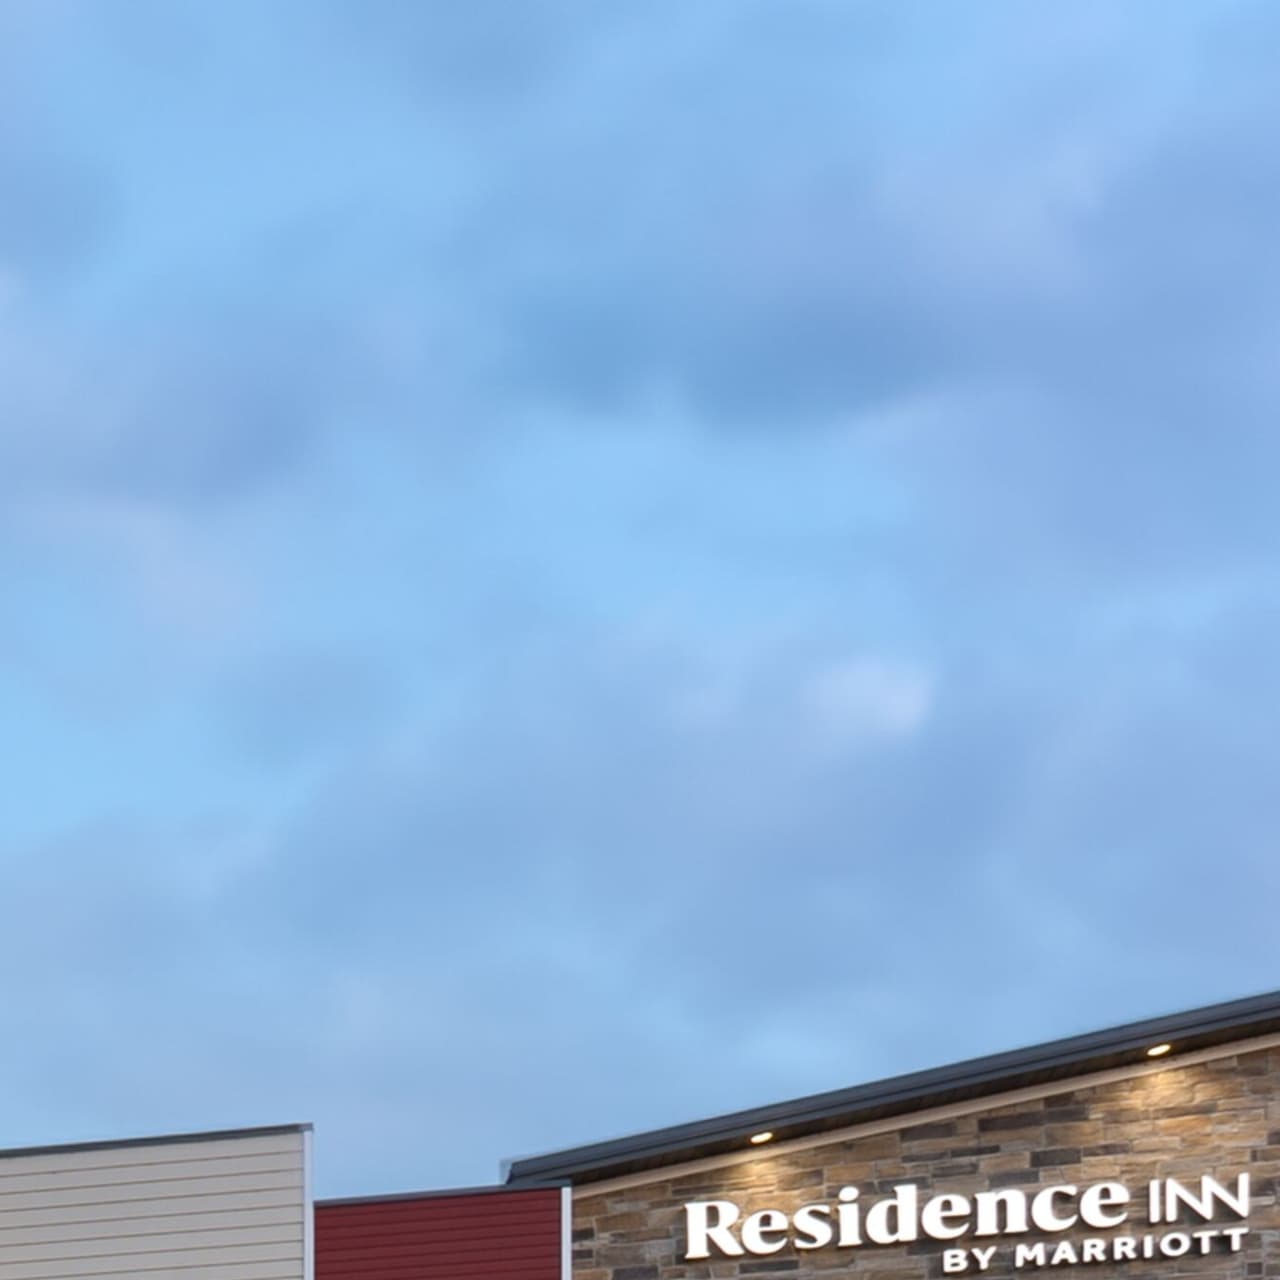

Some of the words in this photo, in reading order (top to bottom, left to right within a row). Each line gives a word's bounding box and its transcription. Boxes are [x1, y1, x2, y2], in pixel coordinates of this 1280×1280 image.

[683, 1181, 1131, 1259] Residence
[1148, 1172, 1251, 1224] INN
[942, 1245, 998, 1273] BY
[1014, 1227, 1250, 1268] MARRIOTT
